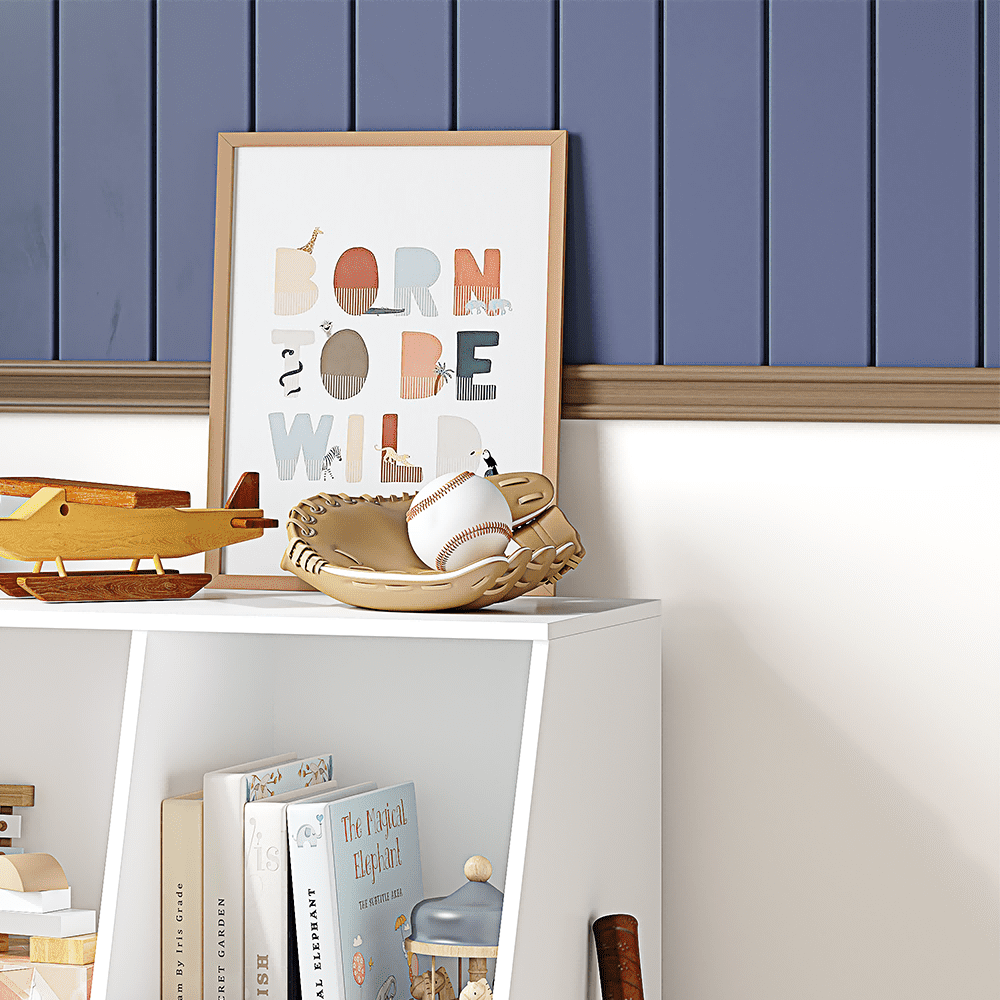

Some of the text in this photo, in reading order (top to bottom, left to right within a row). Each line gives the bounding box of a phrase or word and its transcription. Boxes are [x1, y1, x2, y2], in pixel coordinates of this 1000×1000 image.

[273, 246, 502, 317] BORN
[270, 328, 500, 401] TO BE
[267, 411, 483, 483] WILD
[341, 798, 408, 843] The Magical
[353, 837, 403, 885] Elephant
[175, 882, 184, 922] Grade
[217, 897, 226, 958] GARDEN
[175, 929, 184, 954] Iris
[307, 888, 321, 971] ELEPHANT
[175, 960, 185, 977] By
